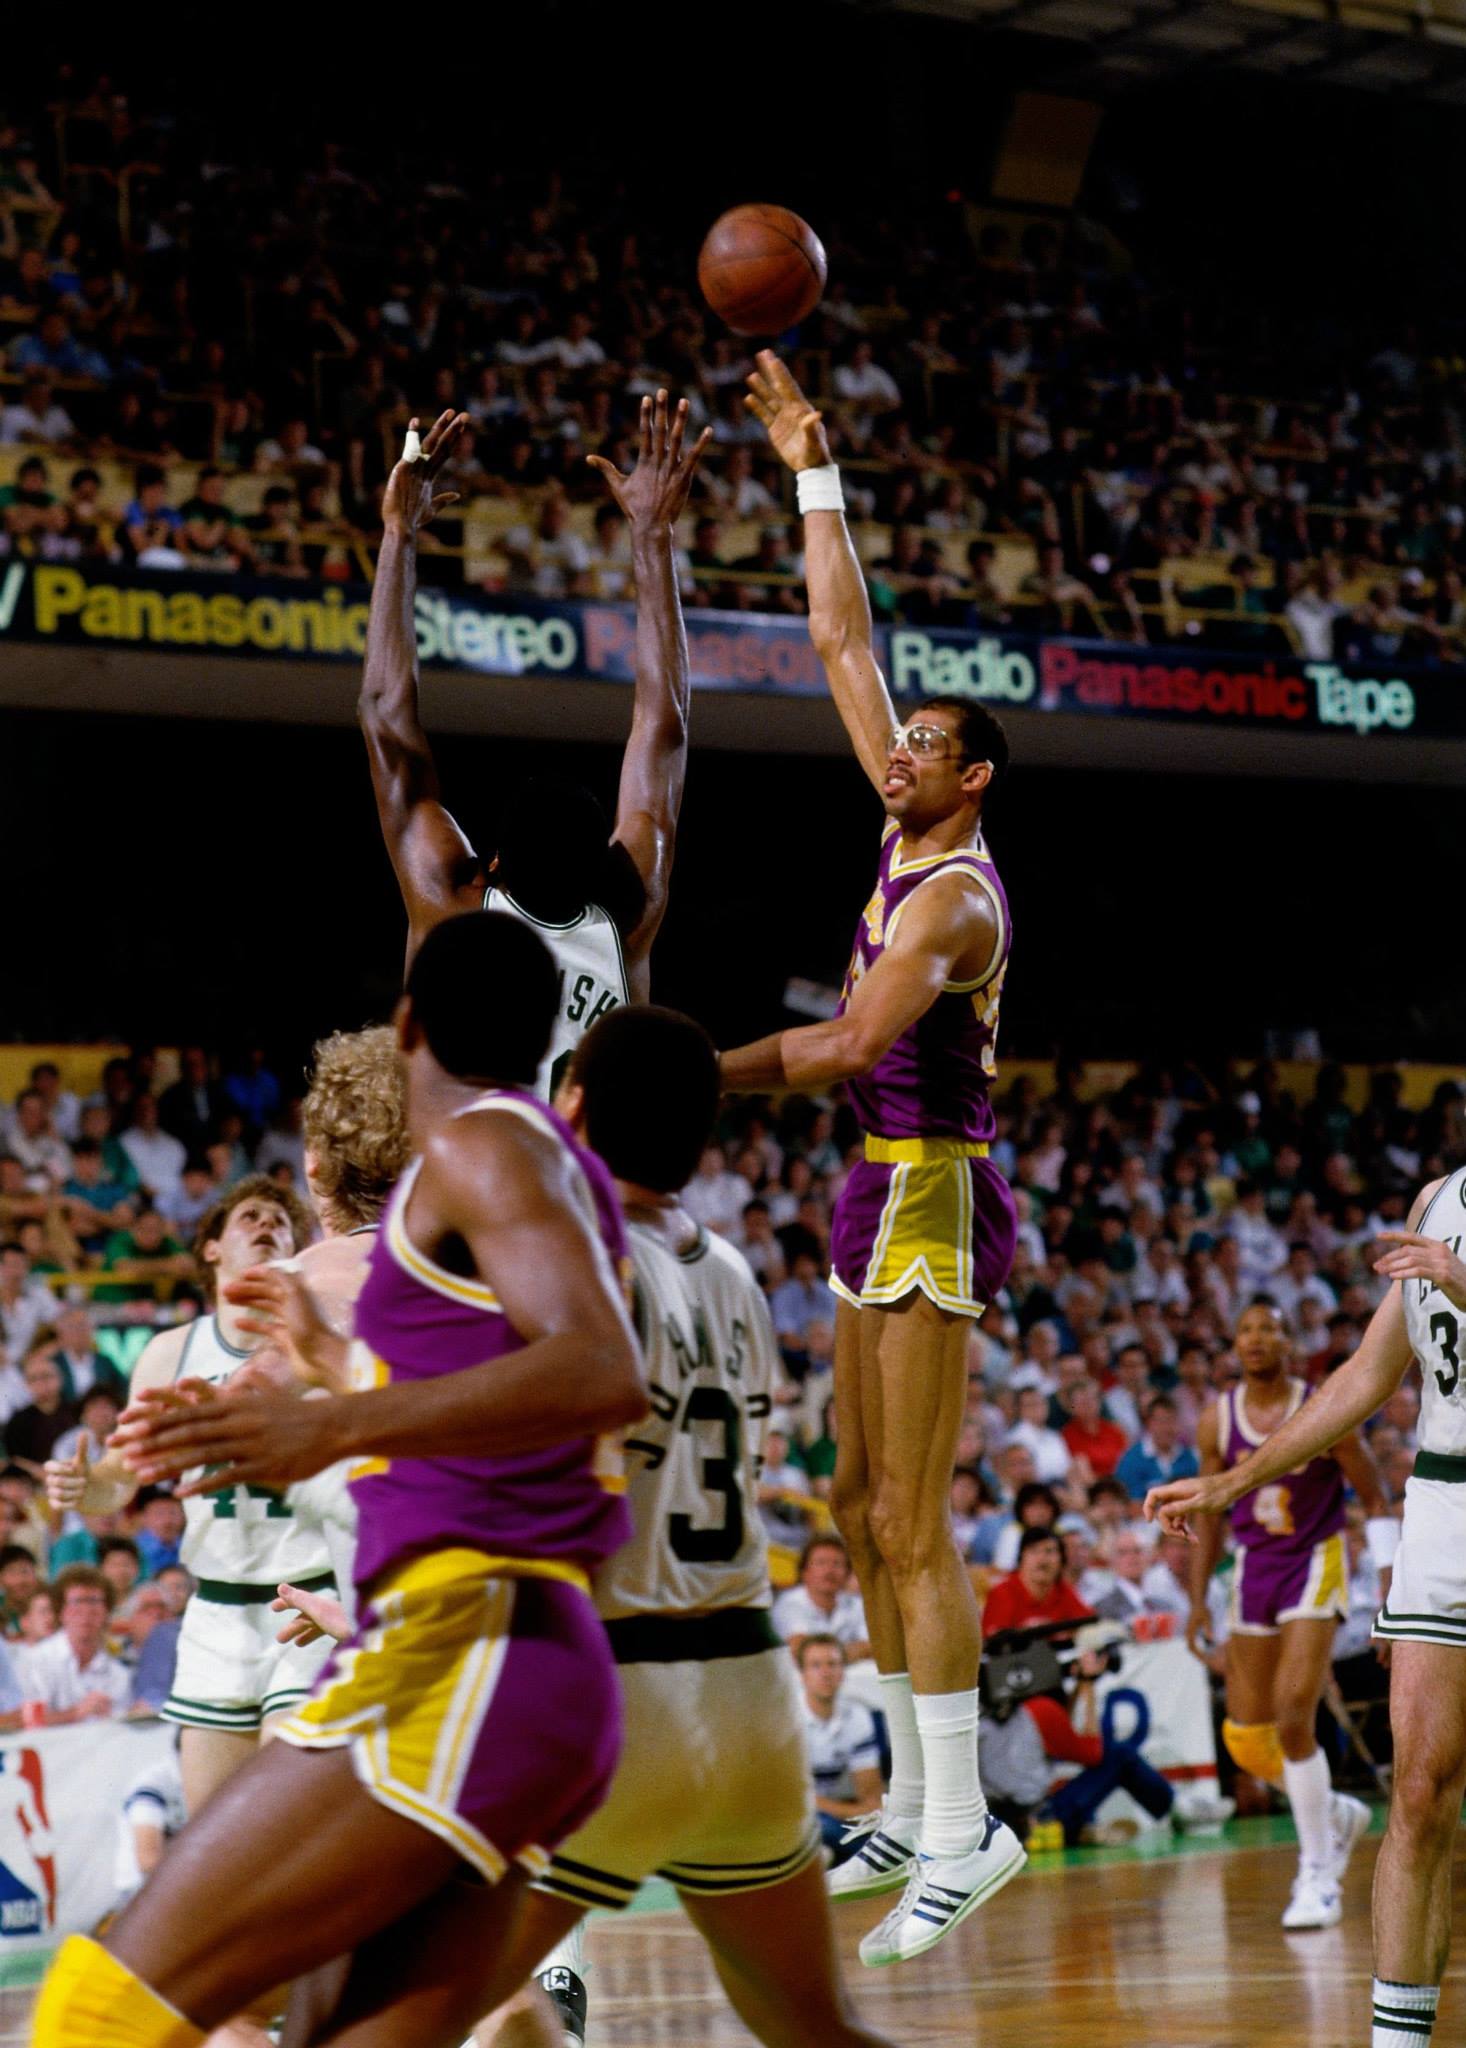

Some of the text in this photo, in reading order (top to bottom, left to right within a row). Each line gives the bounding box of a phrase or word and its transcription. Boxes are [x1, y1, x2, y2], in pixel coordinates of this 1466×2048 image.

[33, 566, 367, 654] Panasonic
[414, 593, 577, 672] Stereo
[891, 631, 1036, 702] Radio
[1040, 643, 1415, 734] Panasonic Tape
[668, 1387, 744, 1562] 3
